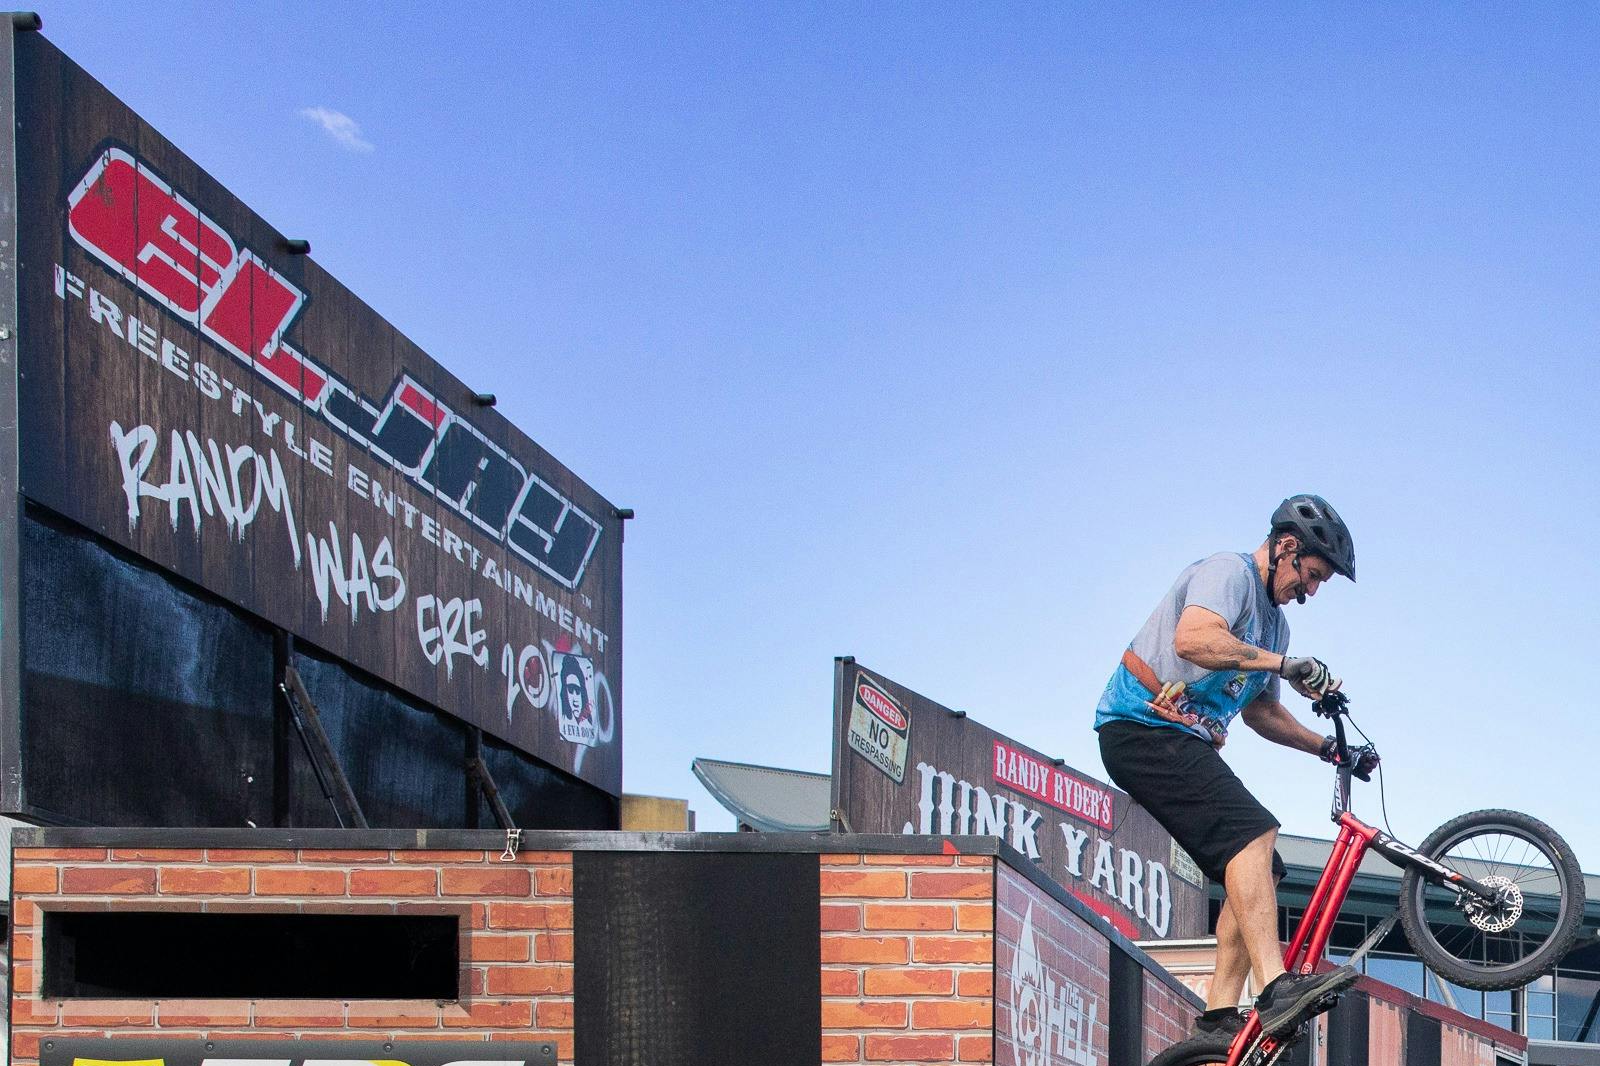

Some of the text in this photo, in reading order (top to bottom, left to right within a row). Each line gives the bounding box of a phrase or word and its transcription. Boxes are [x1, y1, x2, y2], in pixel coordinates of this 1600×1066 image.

[55, 263, 608, 653] FREESTYLE ENTERTAINMENT
[110, 420, 301, 570] RANDY
[309, 521, 406, 625] WAS
[416, 594, 490, 682] ERE
[863, 687, 902, 727] DANGER
[869, 719, 889, 750] NO
[851, 729, 902, 778] TRESPASSING
[996, 744, 1111, 827] RANDY RYDER'S
[1059, 821, 1172, 939] YARD
